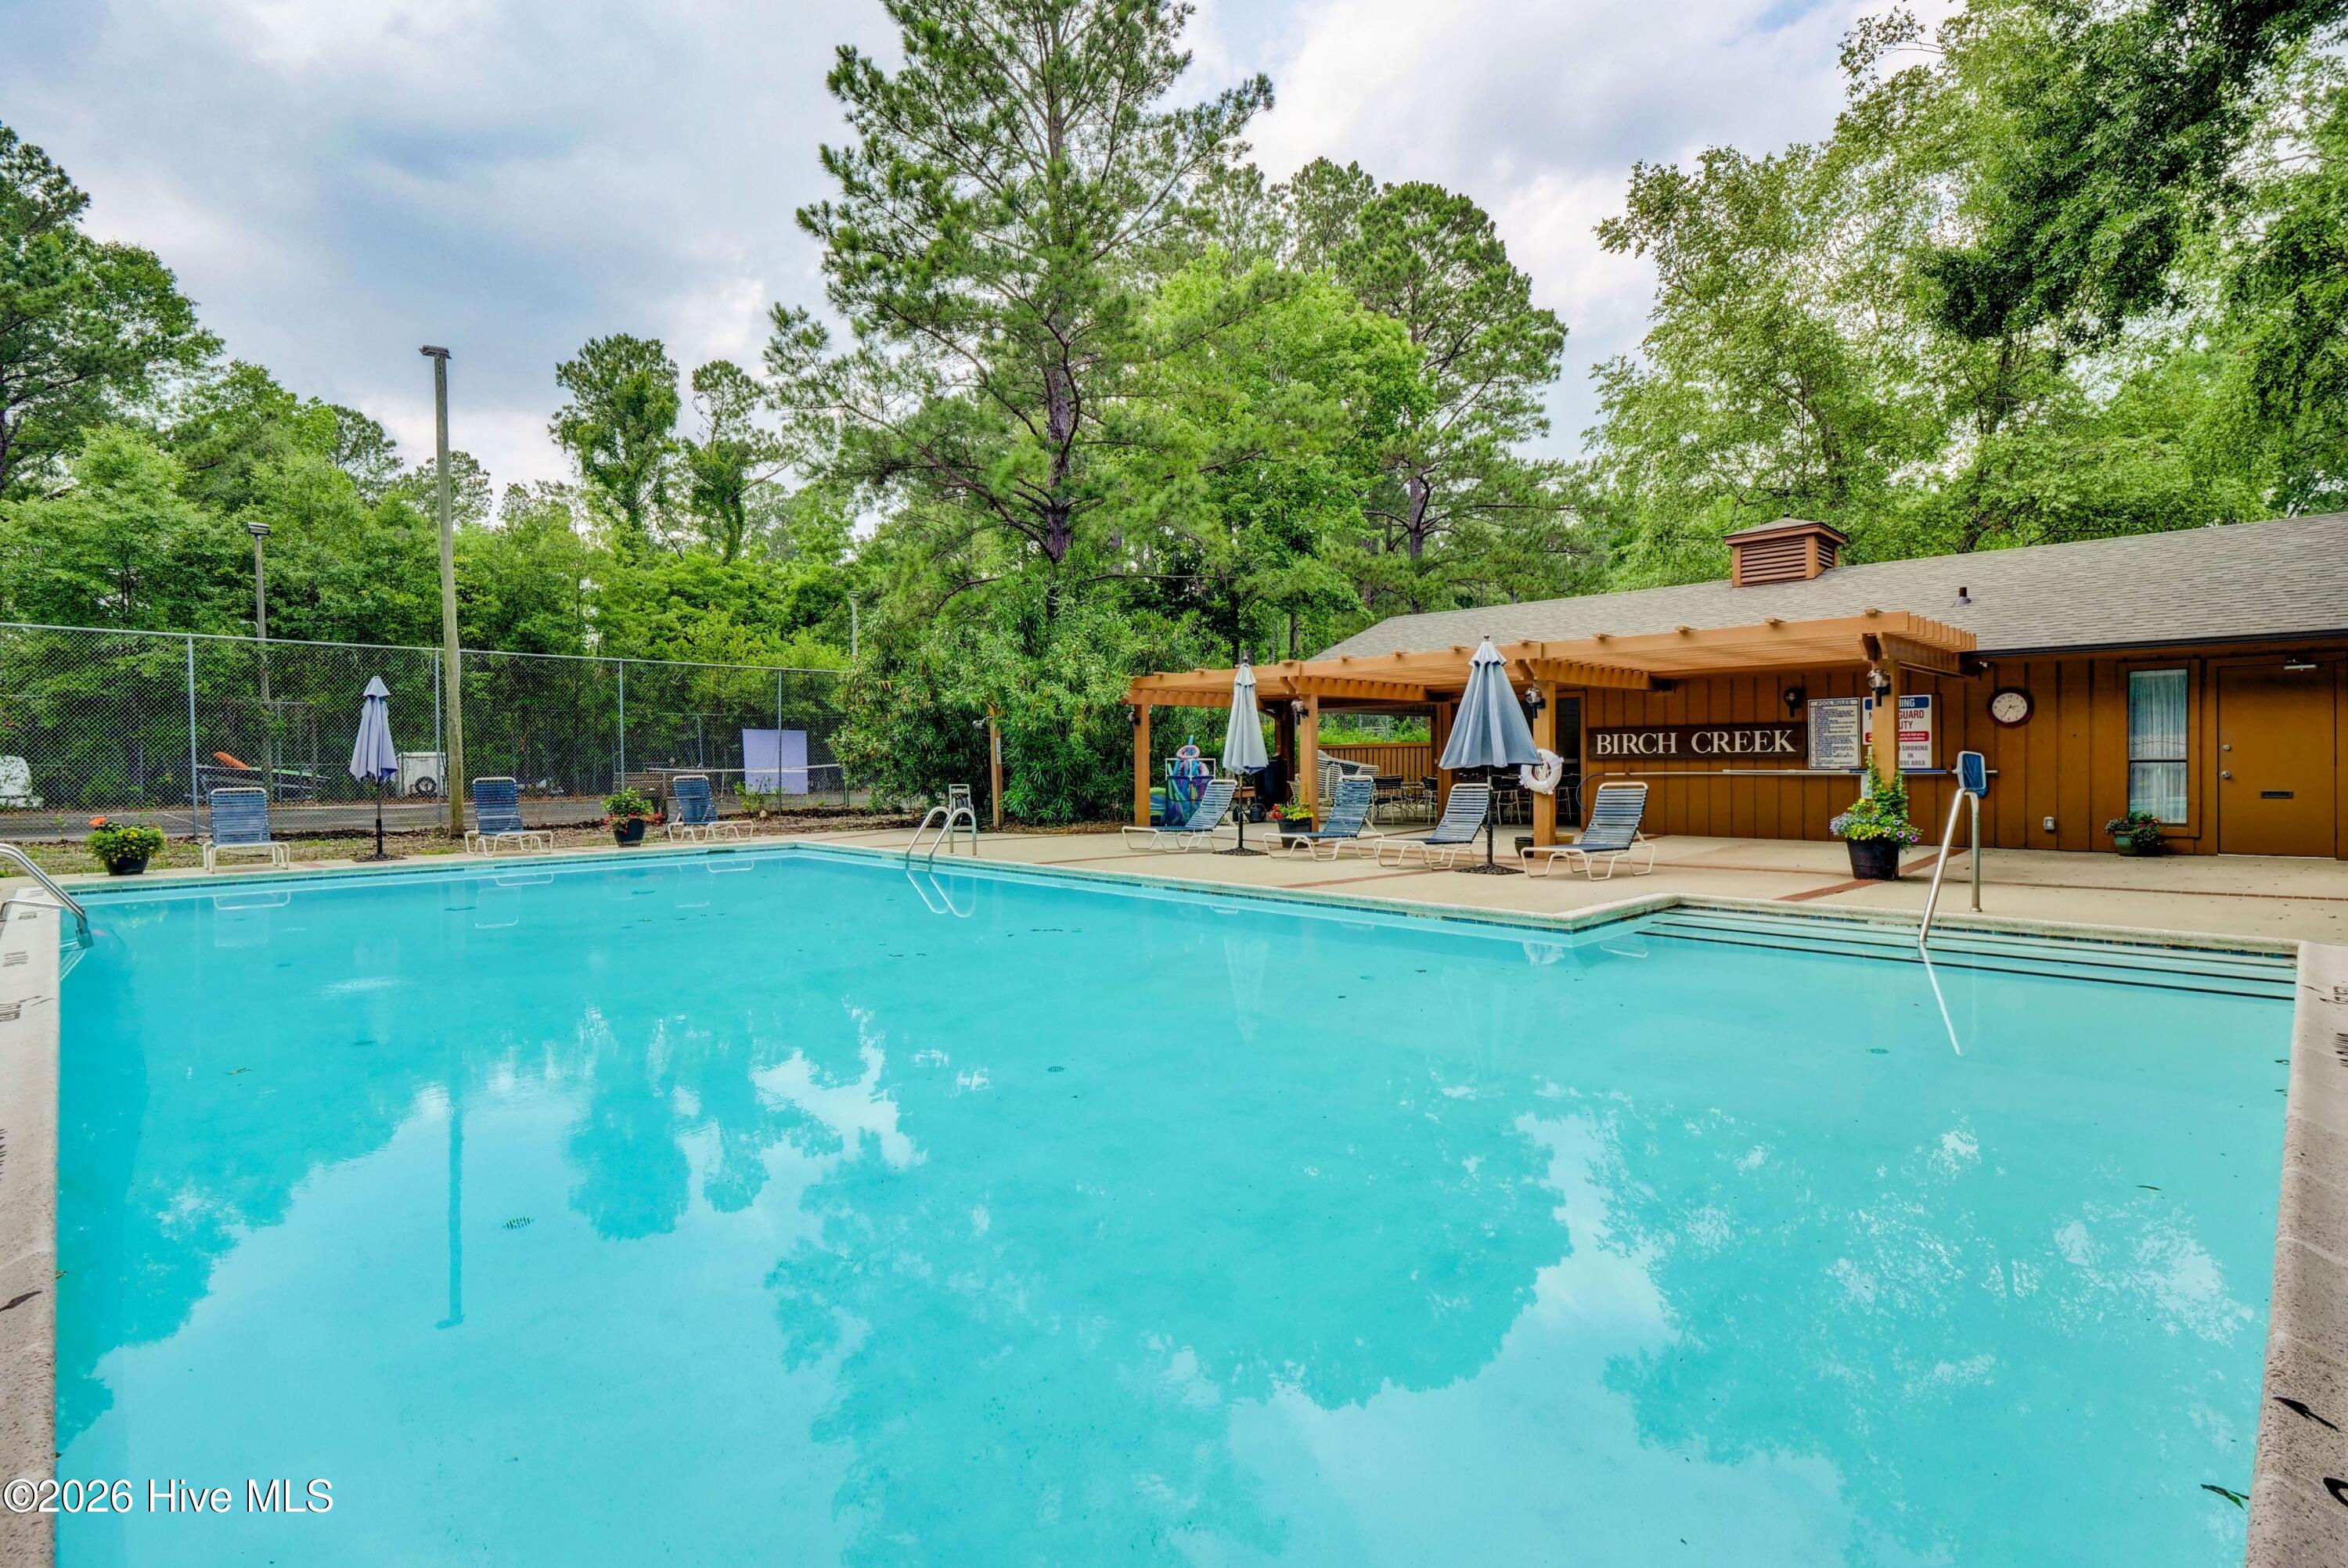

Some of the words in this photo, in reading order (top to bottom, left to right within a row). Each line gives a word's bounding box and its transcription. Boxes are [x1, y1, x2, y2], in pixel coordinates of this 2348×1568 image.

[1899, 710, 1925, 719] GUARD
[1899, 721, 1913, 729] UTY
[1596, 732, 1678, 755] BIRCH
[1691, 730, 1797, 753] CREEK
